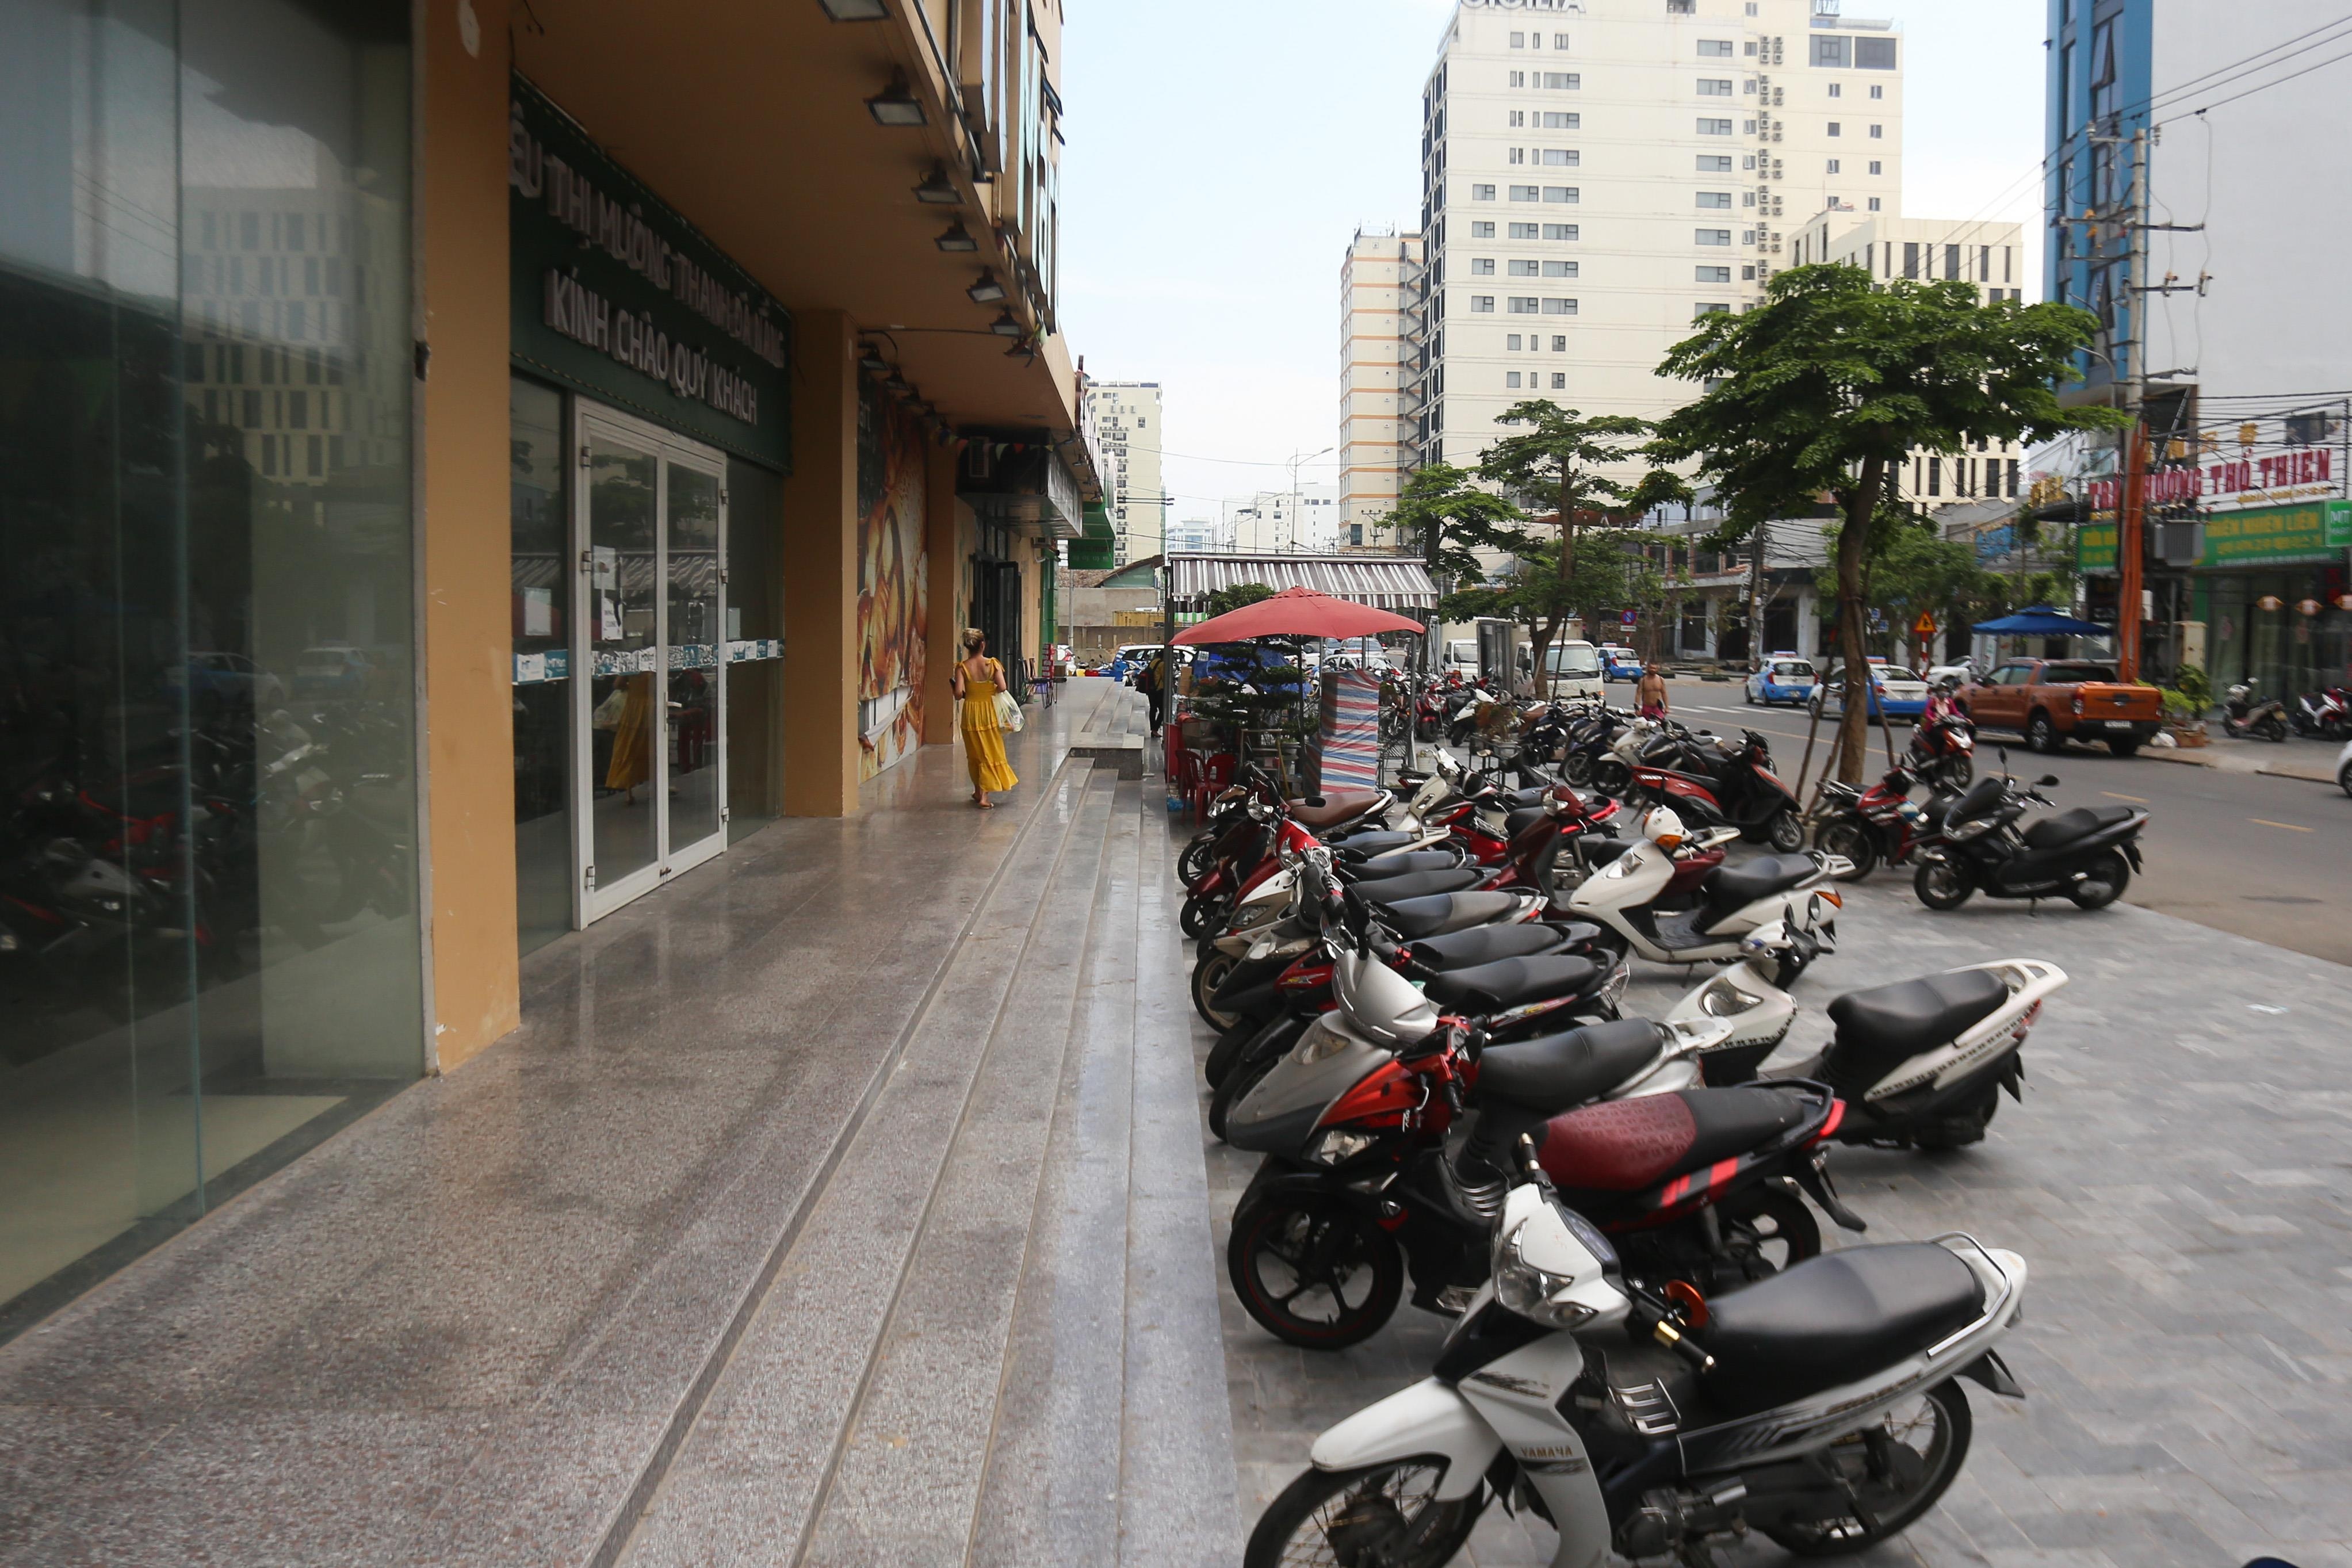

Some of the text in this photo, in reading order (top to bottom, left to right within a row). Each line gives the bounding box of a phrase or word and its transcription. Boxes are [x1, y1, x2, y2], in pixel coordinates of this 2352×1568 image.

[544, 266, 757, 425] KÍNH CHÀO QUÝ KHÁCH
[1521, 1445, 1574, 1459] YAMAHA
